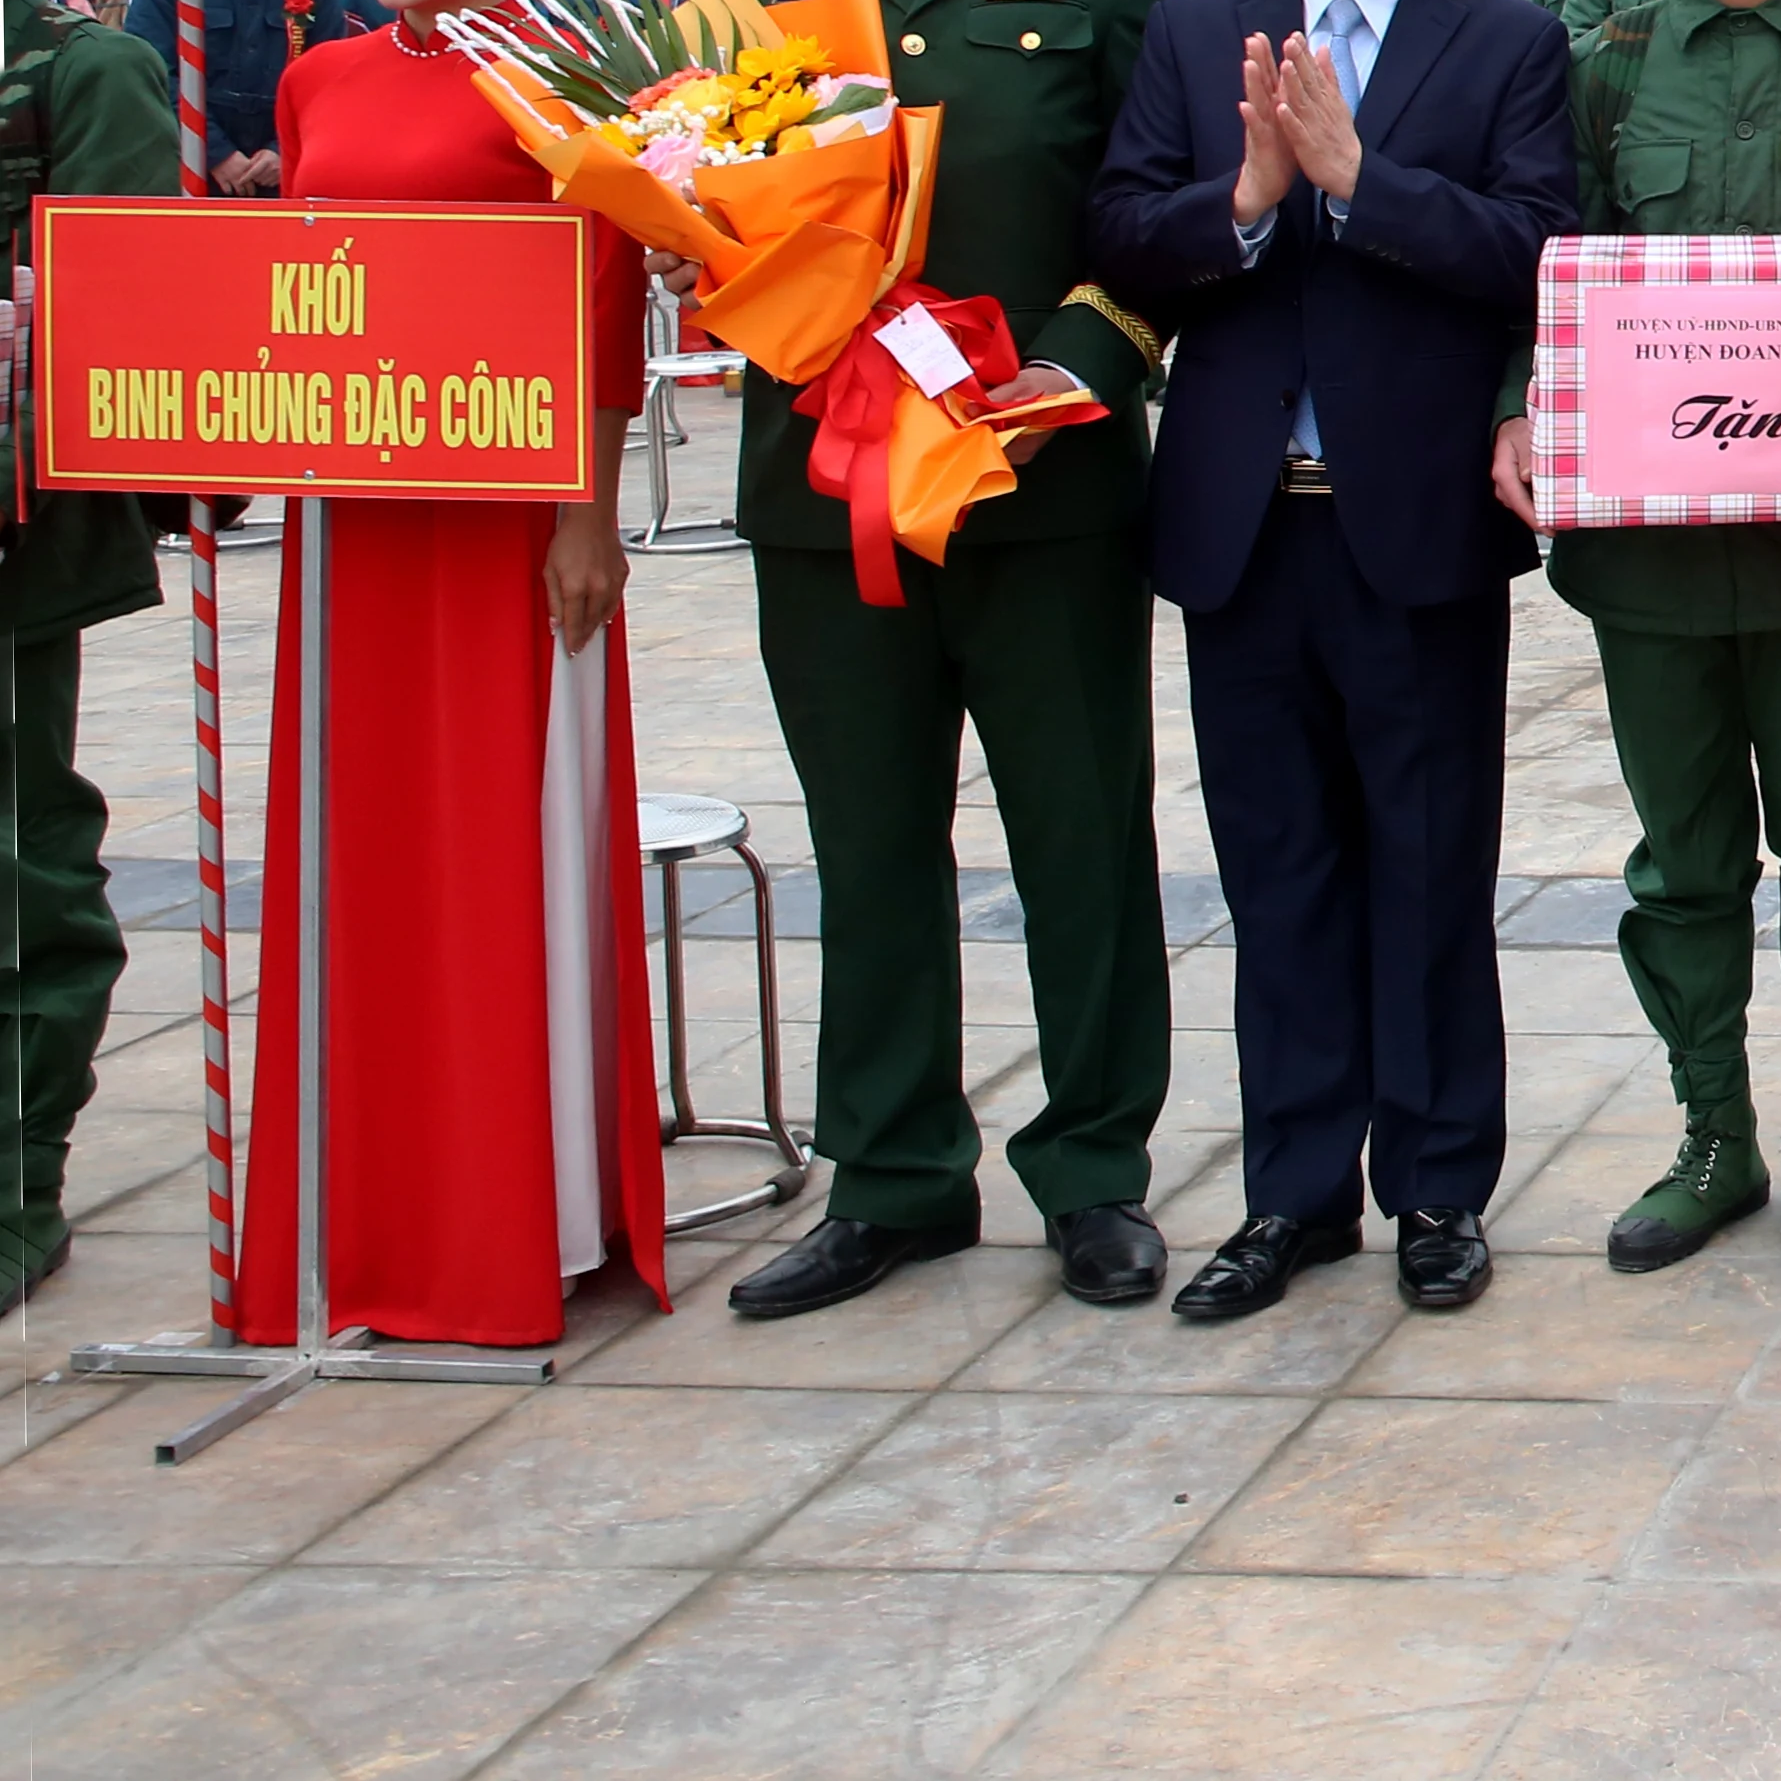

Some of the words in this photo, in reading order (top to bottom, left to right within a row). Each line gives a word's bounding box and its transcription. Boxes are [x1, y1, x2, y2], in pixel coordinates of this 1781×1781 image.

[271, 237, 366, 336] KHỐI
[1616, 317, 1673, 334] HUYỆN
[1635, 341, 1713, 364] HUYỆN
[1719, 344, 1781, 360] ĐOAN
[89, 367, 184, 441] BINH
[196, 346, 333, 446] CHỦNG
[344, 358, 427, 464] ĐẶC
[440, 360, 554, 450] CÔNG
